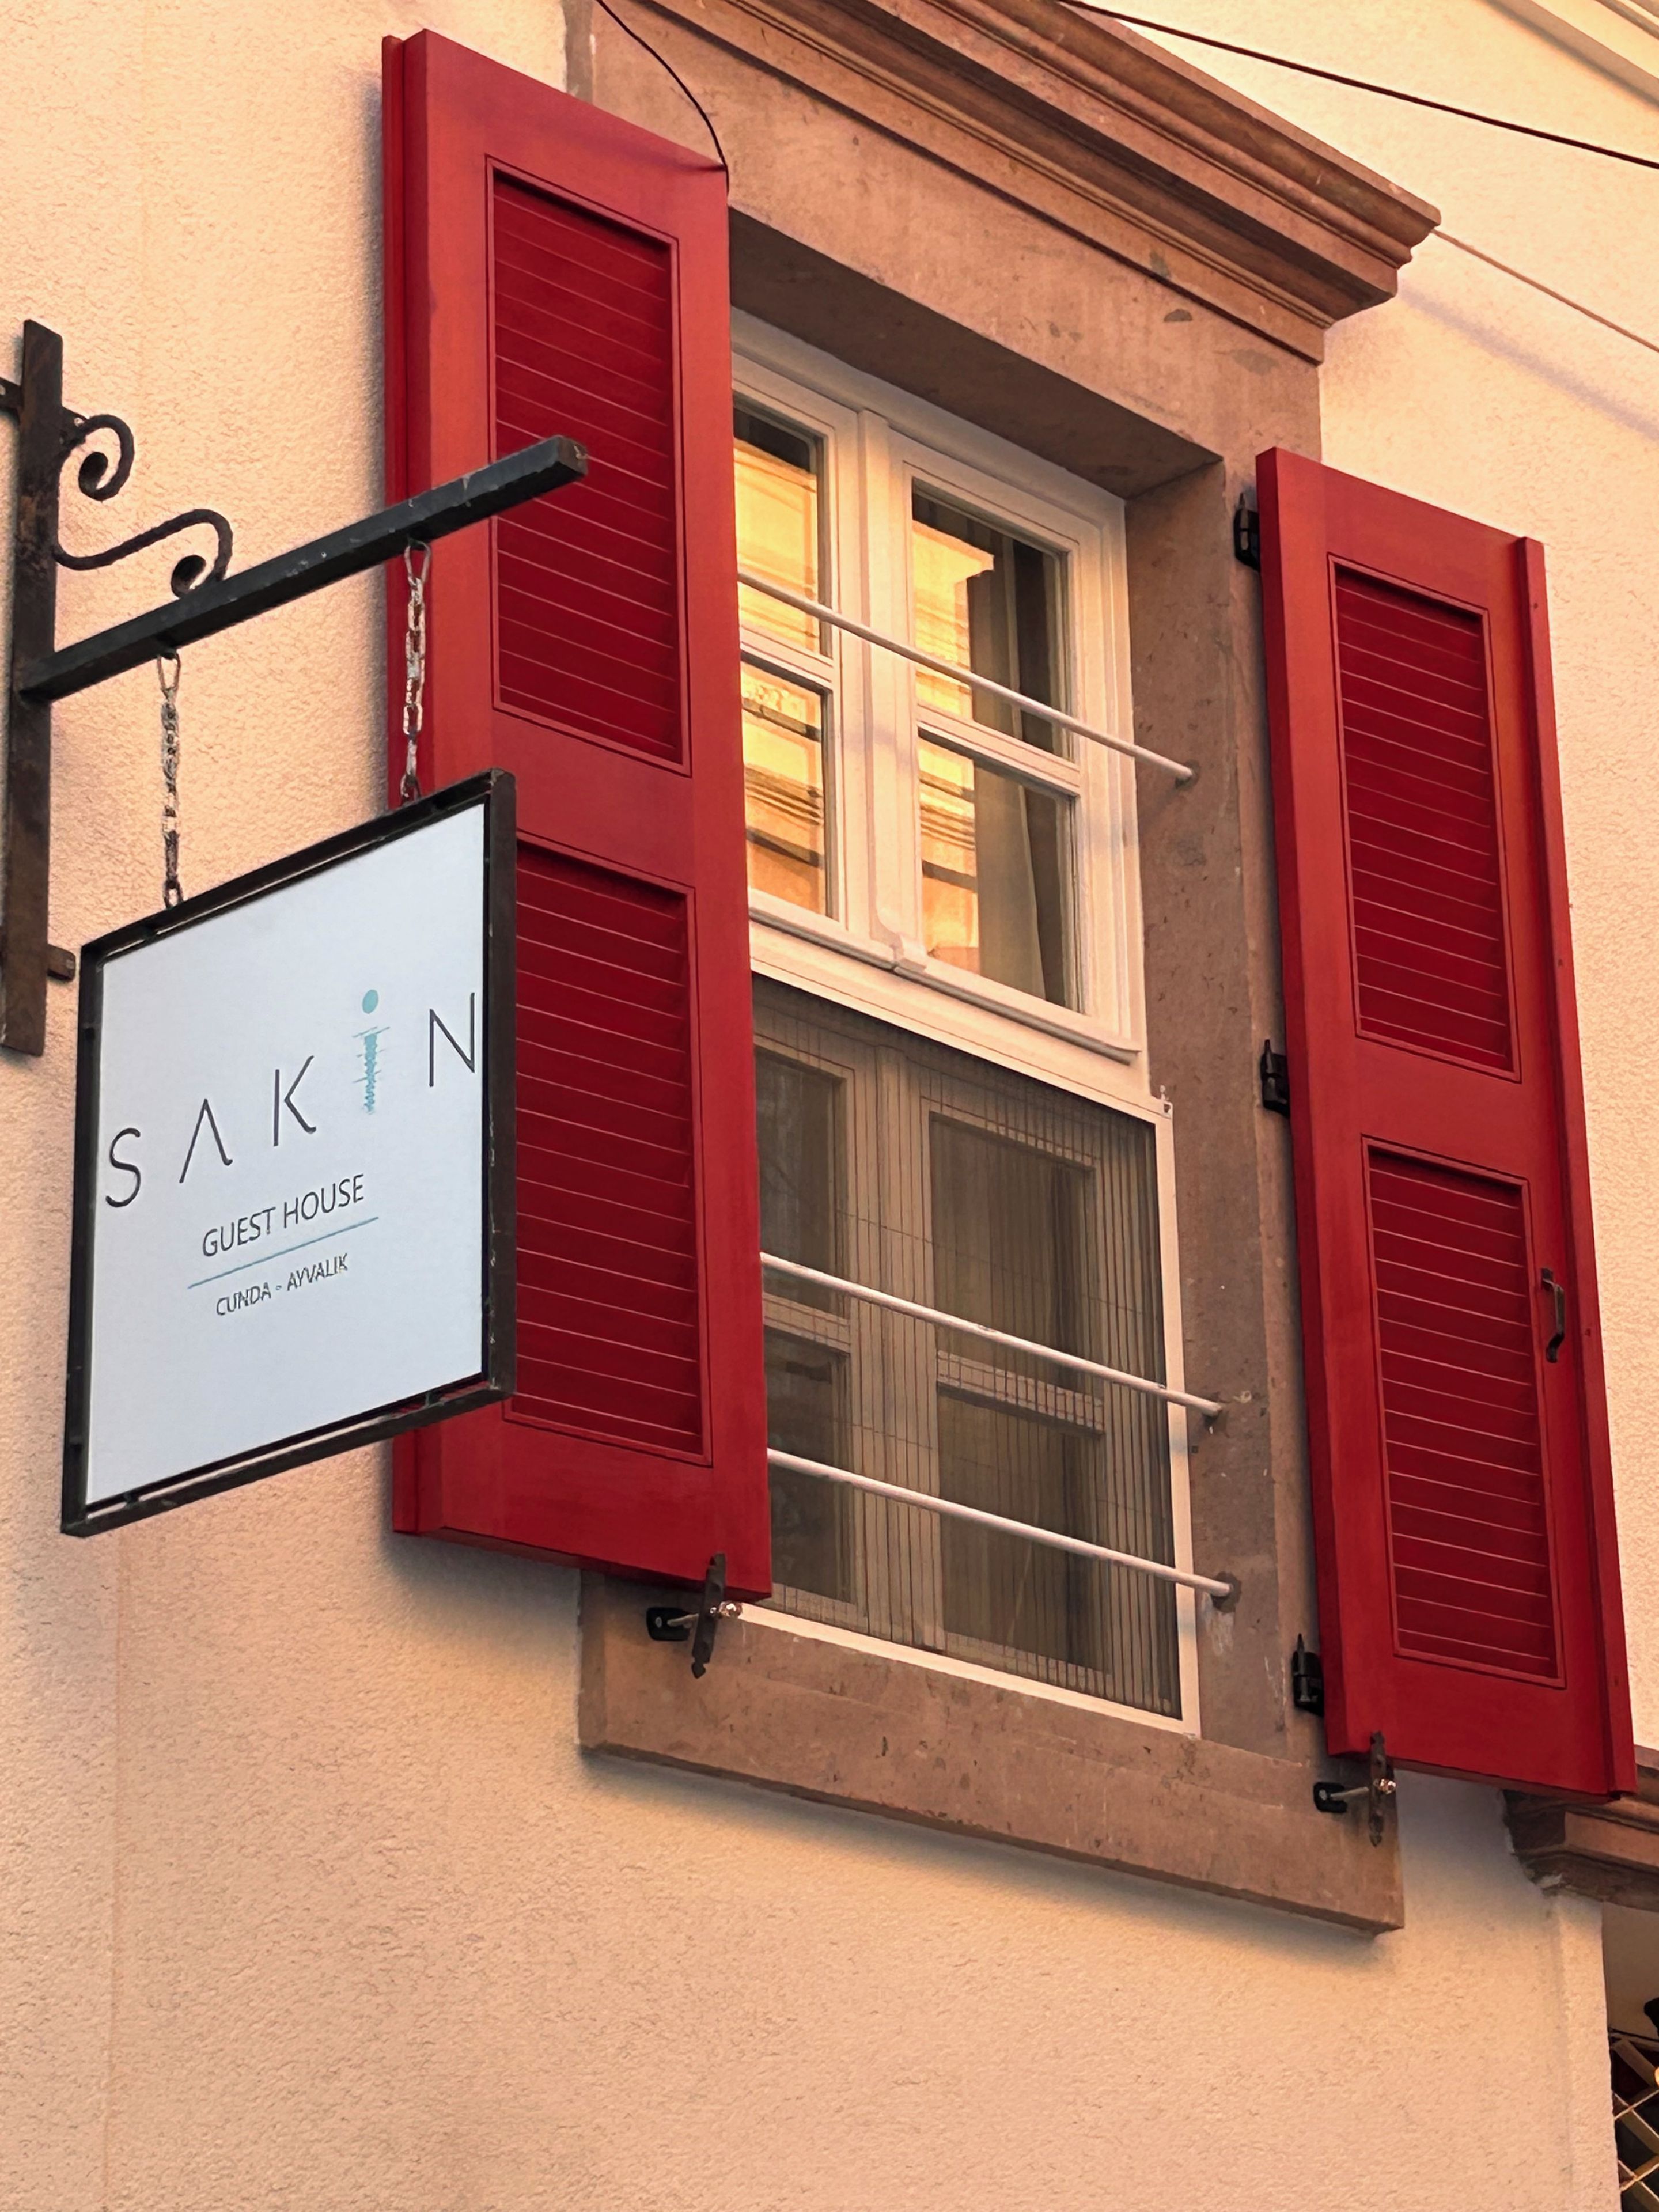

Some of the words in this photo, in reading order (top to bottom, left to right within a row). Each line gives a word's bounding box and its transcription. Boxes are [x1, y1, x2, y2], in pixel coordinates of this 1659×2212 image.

[202, 1207, 276, 1257] GUEST
[282, 1173, 365, 1230] HOUSE
[215, 1282, 272, 1316] CUNDA
[286, 1252, 349, 1292] AYVALIK
